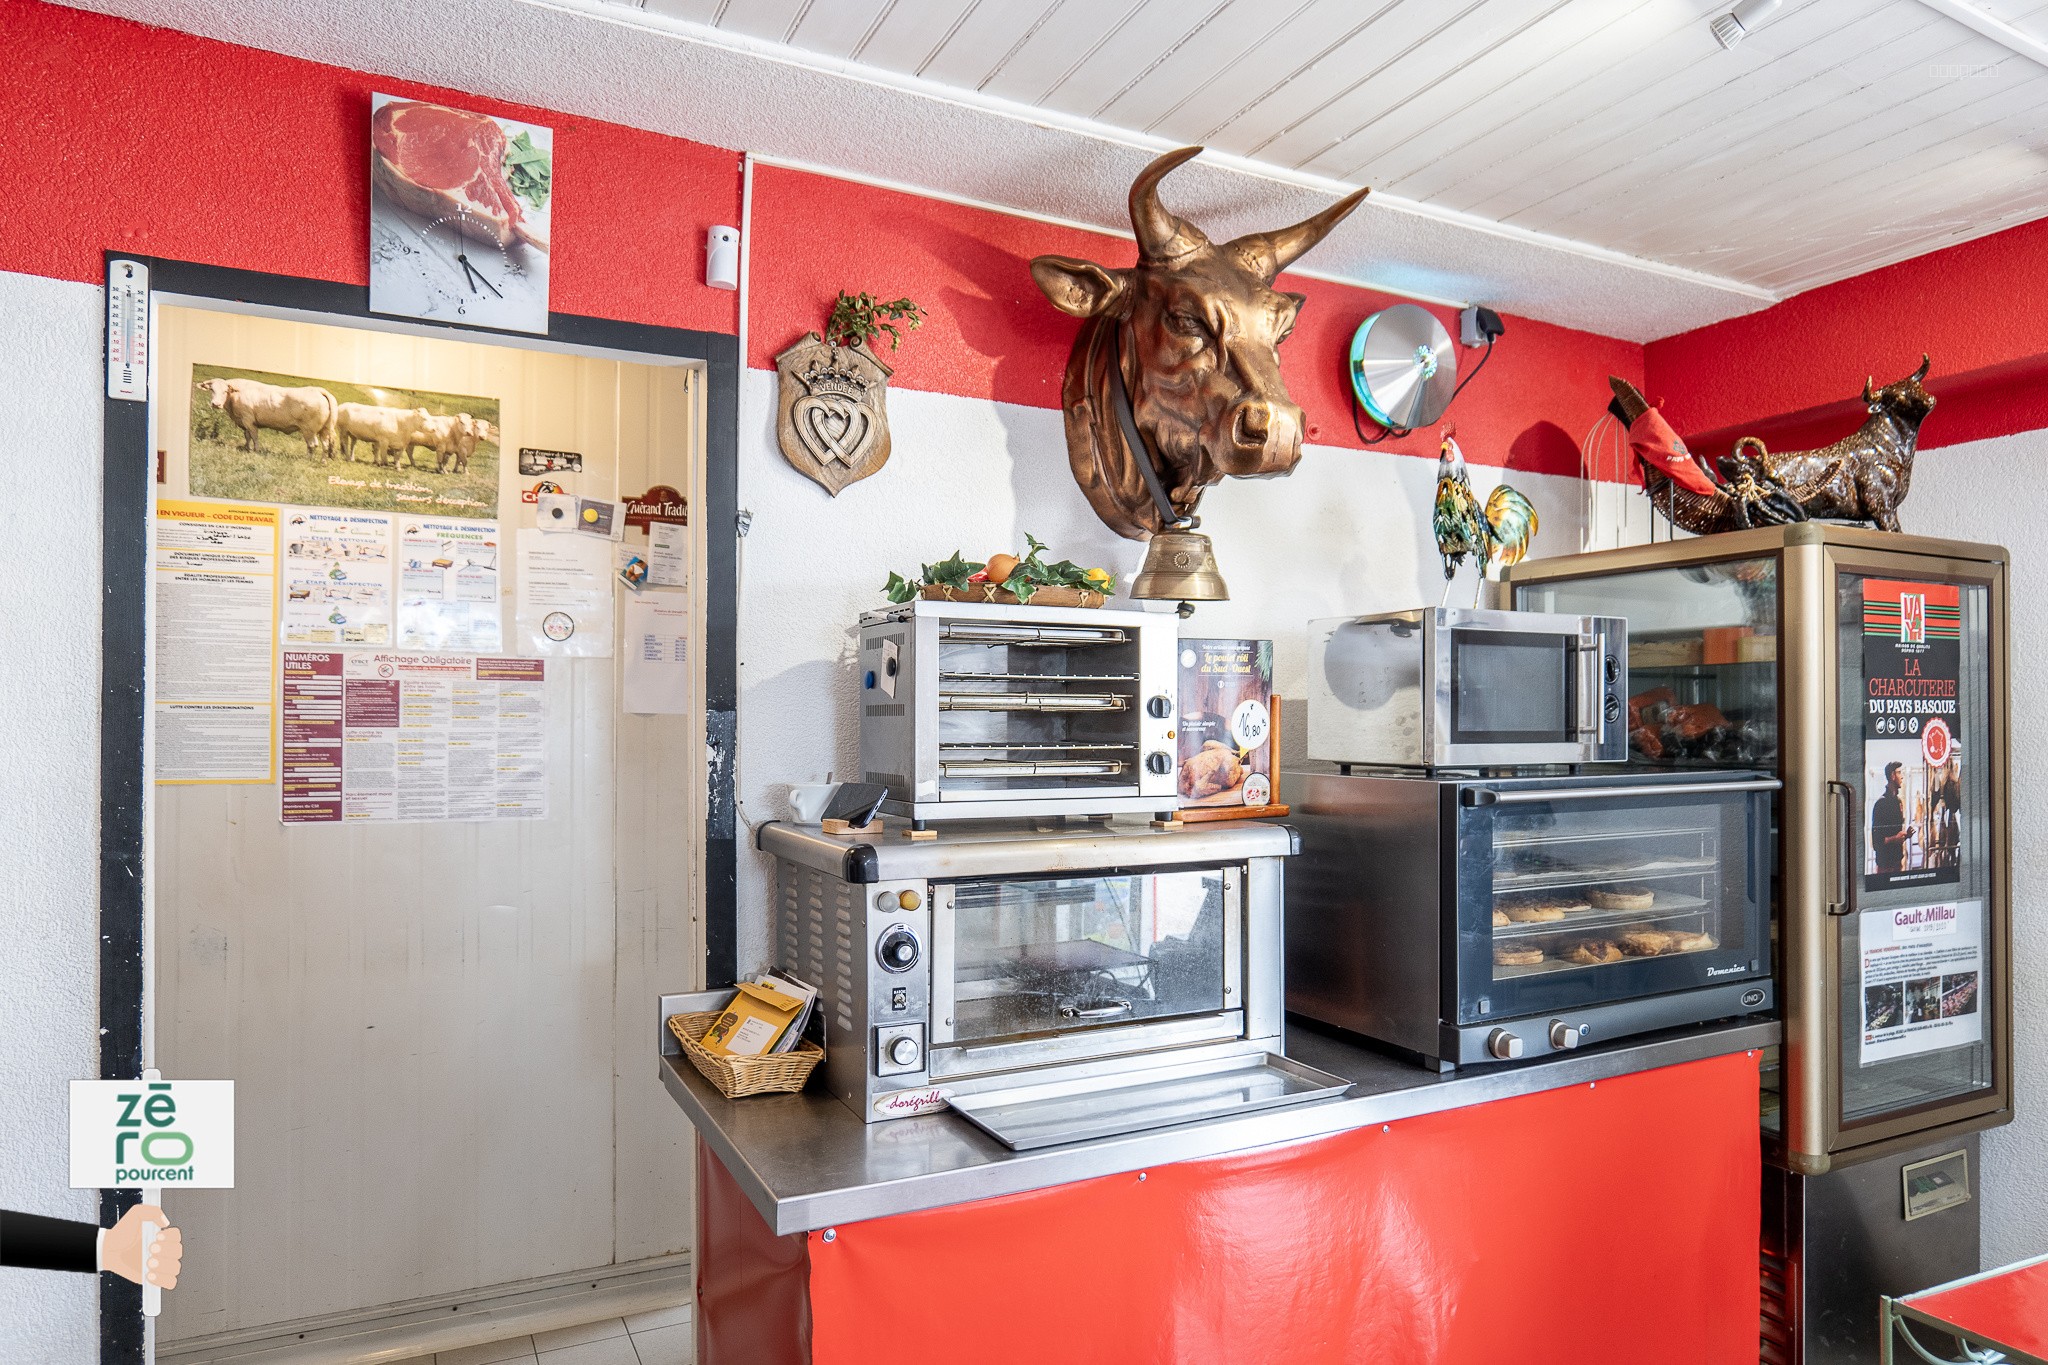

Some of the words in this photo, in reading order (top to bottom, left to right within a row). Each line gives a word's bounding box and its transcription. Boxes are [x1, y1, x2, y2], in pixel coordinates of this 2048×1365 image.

[456, 203, 472, 213] 12
[403, 246, 411, 255] 9
[457, 306, 466, 315] 6
[370, 478, 382, 488] de
[212, 513, 232, 521] CODE
[309, 514, 341, 522] NETTOYAGE
[374, 654, 420, 665] Affichage
[421, 655, 472, 666] Obligatoire
[1204, 652, 1213, 664] Le
[1213, 653, 1236, 664] poulet
[285, 661, 312, 670] UTILES
[1201, 664, 1212, 673] du
[1905, 658, 1921, 676] LA
[1869, 678, 1956, 697] CHARCUTERIE
[1869, 699, 1885, 713] DU
[1887, 699, 1913, 714] PAYS
[1914, 700, 1956, 714] BASQUE
[1743, 994, 1758, 1003] UNO
